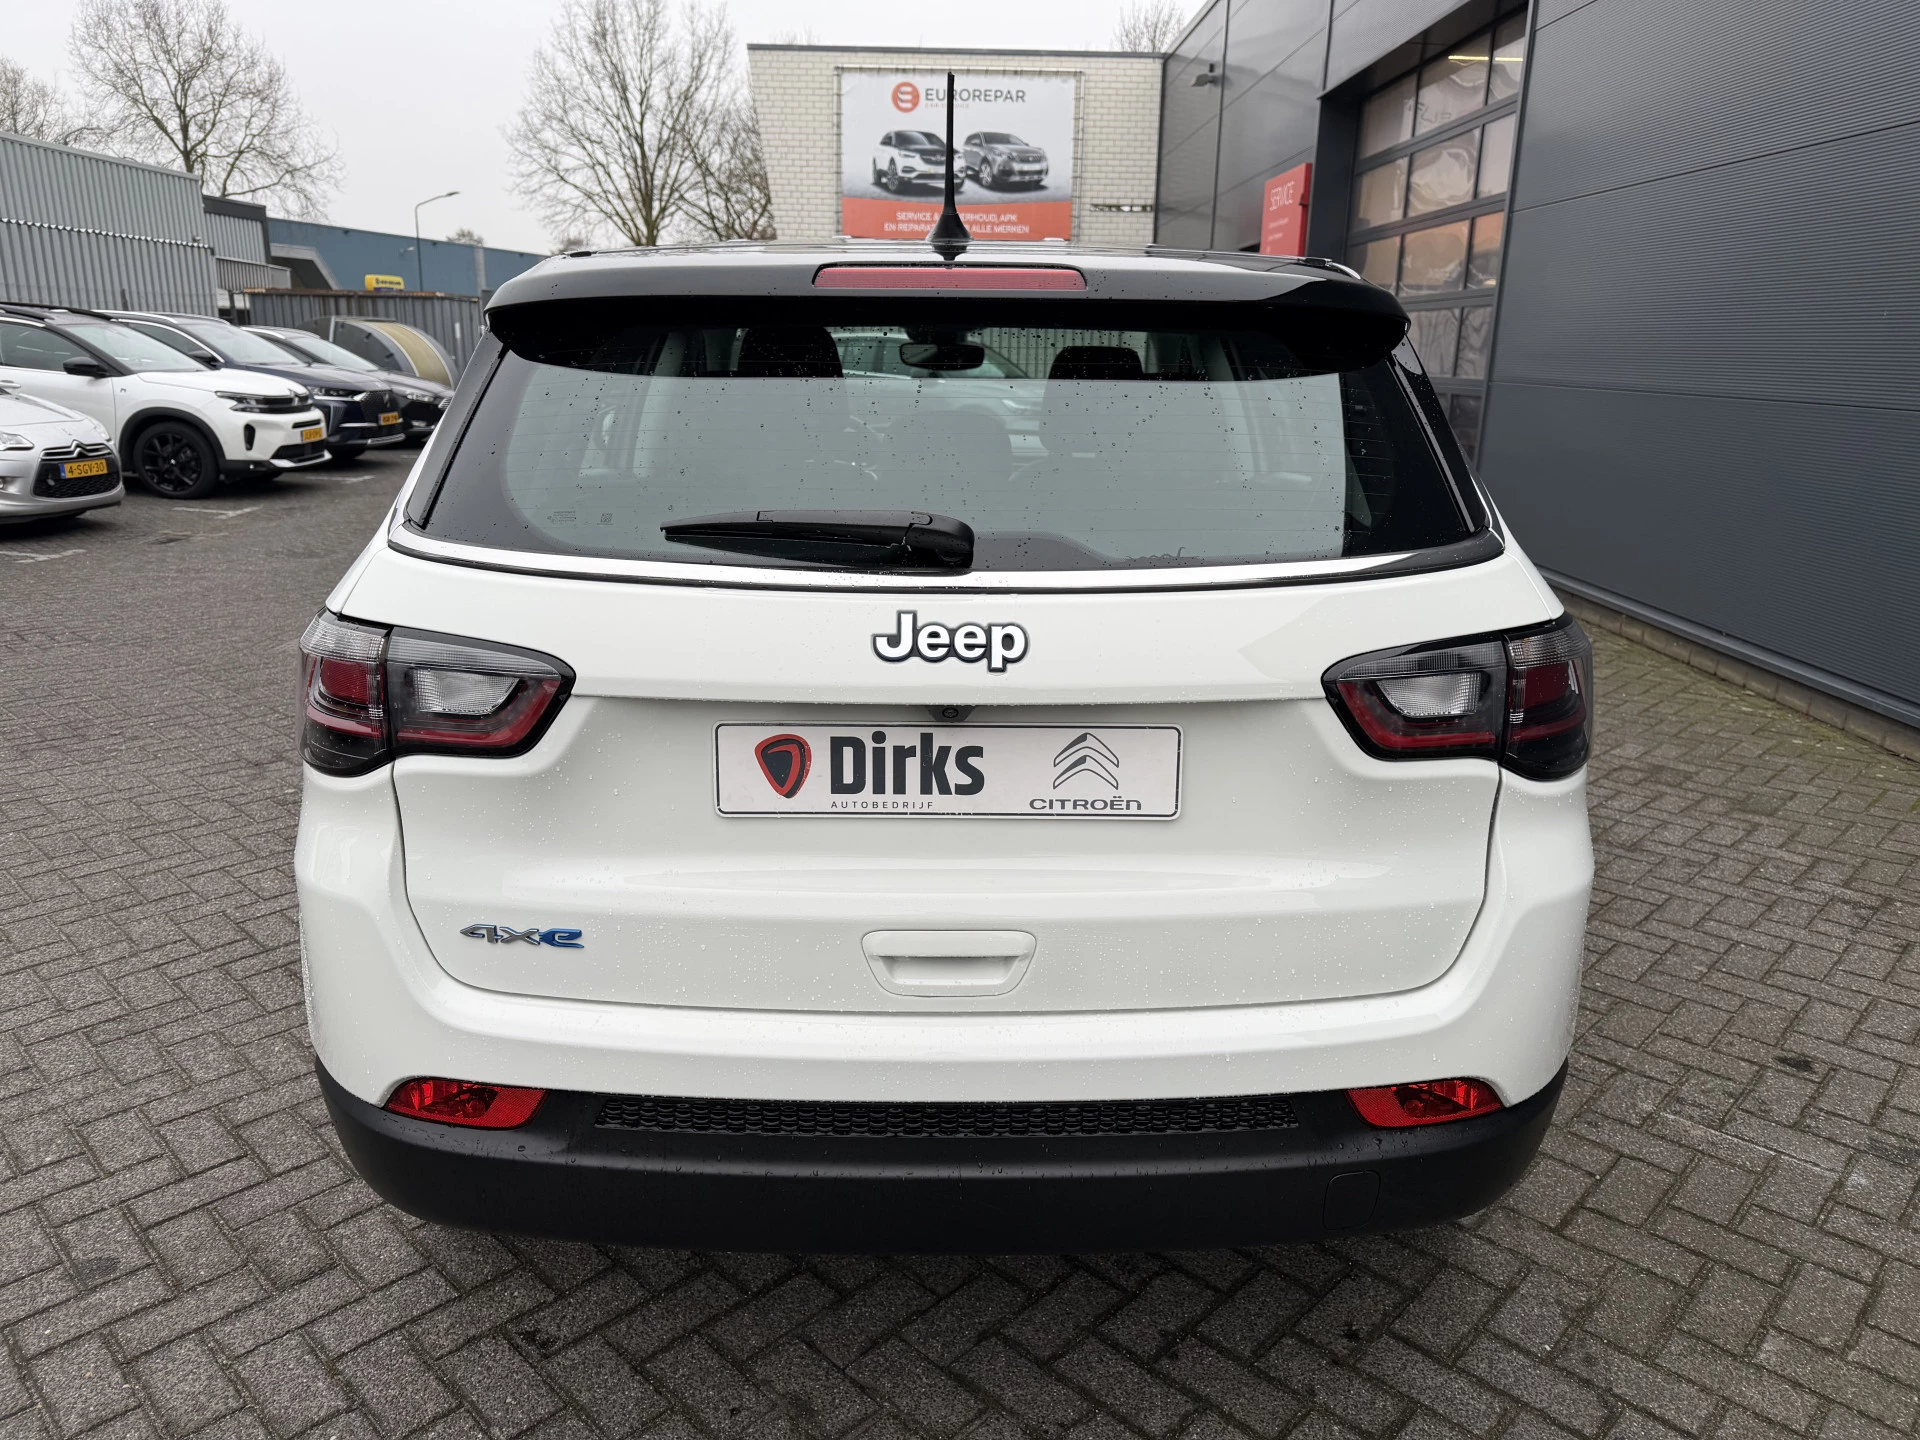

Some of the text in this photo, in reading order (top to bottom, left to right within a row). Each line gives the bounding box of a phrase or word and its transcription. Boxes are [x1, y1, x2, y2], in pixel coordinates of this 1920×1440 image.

[896, 211, 932, 220] SERVICE
[884, 223, 897, 231] EN
[971, 225, 993, 233] ALLE
[994, 225, 1030, 233] MERKEN
[68, 461, 105, 477] 4-SGV-30
[873, 611, 1029, 671] Jeep
[830, 730, 985, 795] Dirks
[830, 801, 934, 809] AUTOBEDRIJF
